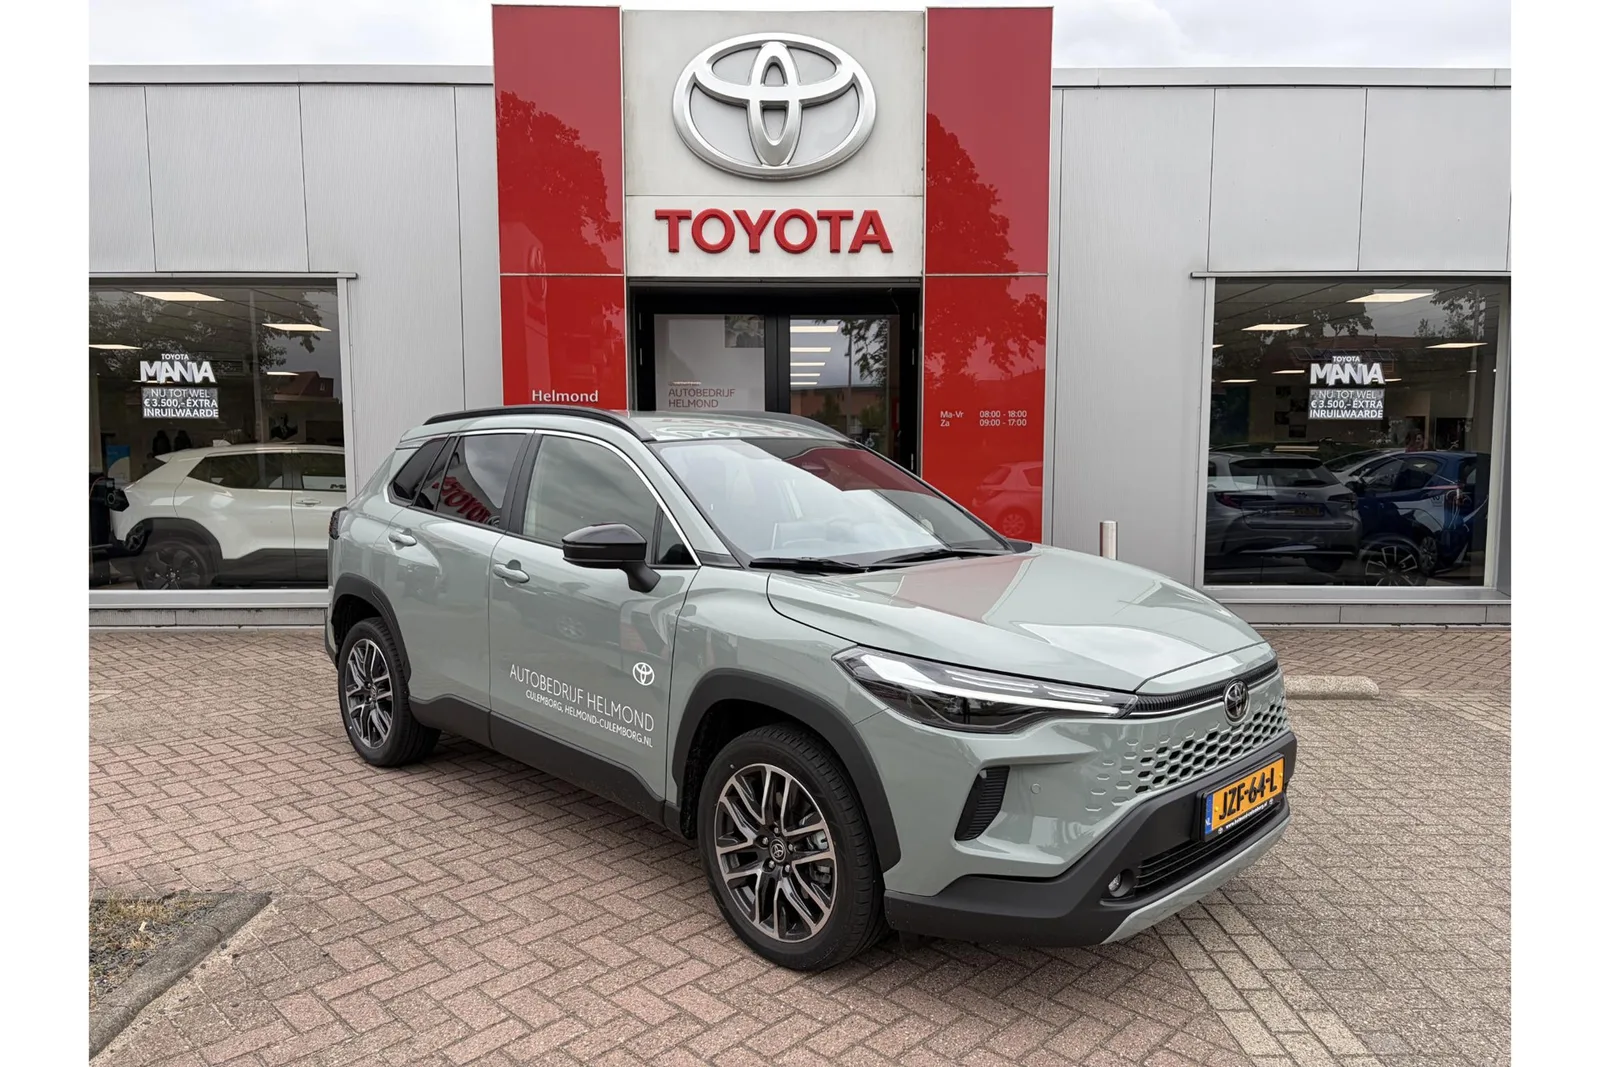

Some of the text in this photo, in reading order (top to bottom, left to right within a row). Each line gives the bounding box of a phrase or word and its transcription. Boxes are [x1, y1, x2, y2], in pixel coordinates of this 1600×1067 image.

[655, 208, 893, 254] TOYOTA
[140, 360, 216, 384] MANIA
[1310, 362, 1385, 386] MANIA
[151, 389, 210, 398] NU TOT WEL
[532, 389, 599, 402] Helmond
[668, 388, 736, 398] AUTOBEDRIJF
[1318, 390, 1377, 399] NU TOT WEL
[668, 399, 719, 408] HELMOND
[143, 408, 219, 417] INRUILWAARDE
[980, 410, 1001, 418] 08:00
[1007, 410, 1028, 418] 18:00
[1309, 410, 1384, 418] INRUILWAARDE
[940, 419, 950, 427] Za
[980, 419, 1001, 427] 09:00
[1007, 419, 1028, 427] 17:00
[509, 664, 655, 732] AUTOBEDRIJF HELMOND
[525, 690, 653, 748] CULEMBORG, HELMOND-CULEMBORG.NL
[1219, 767, 1277, 820] JZF-64-L
